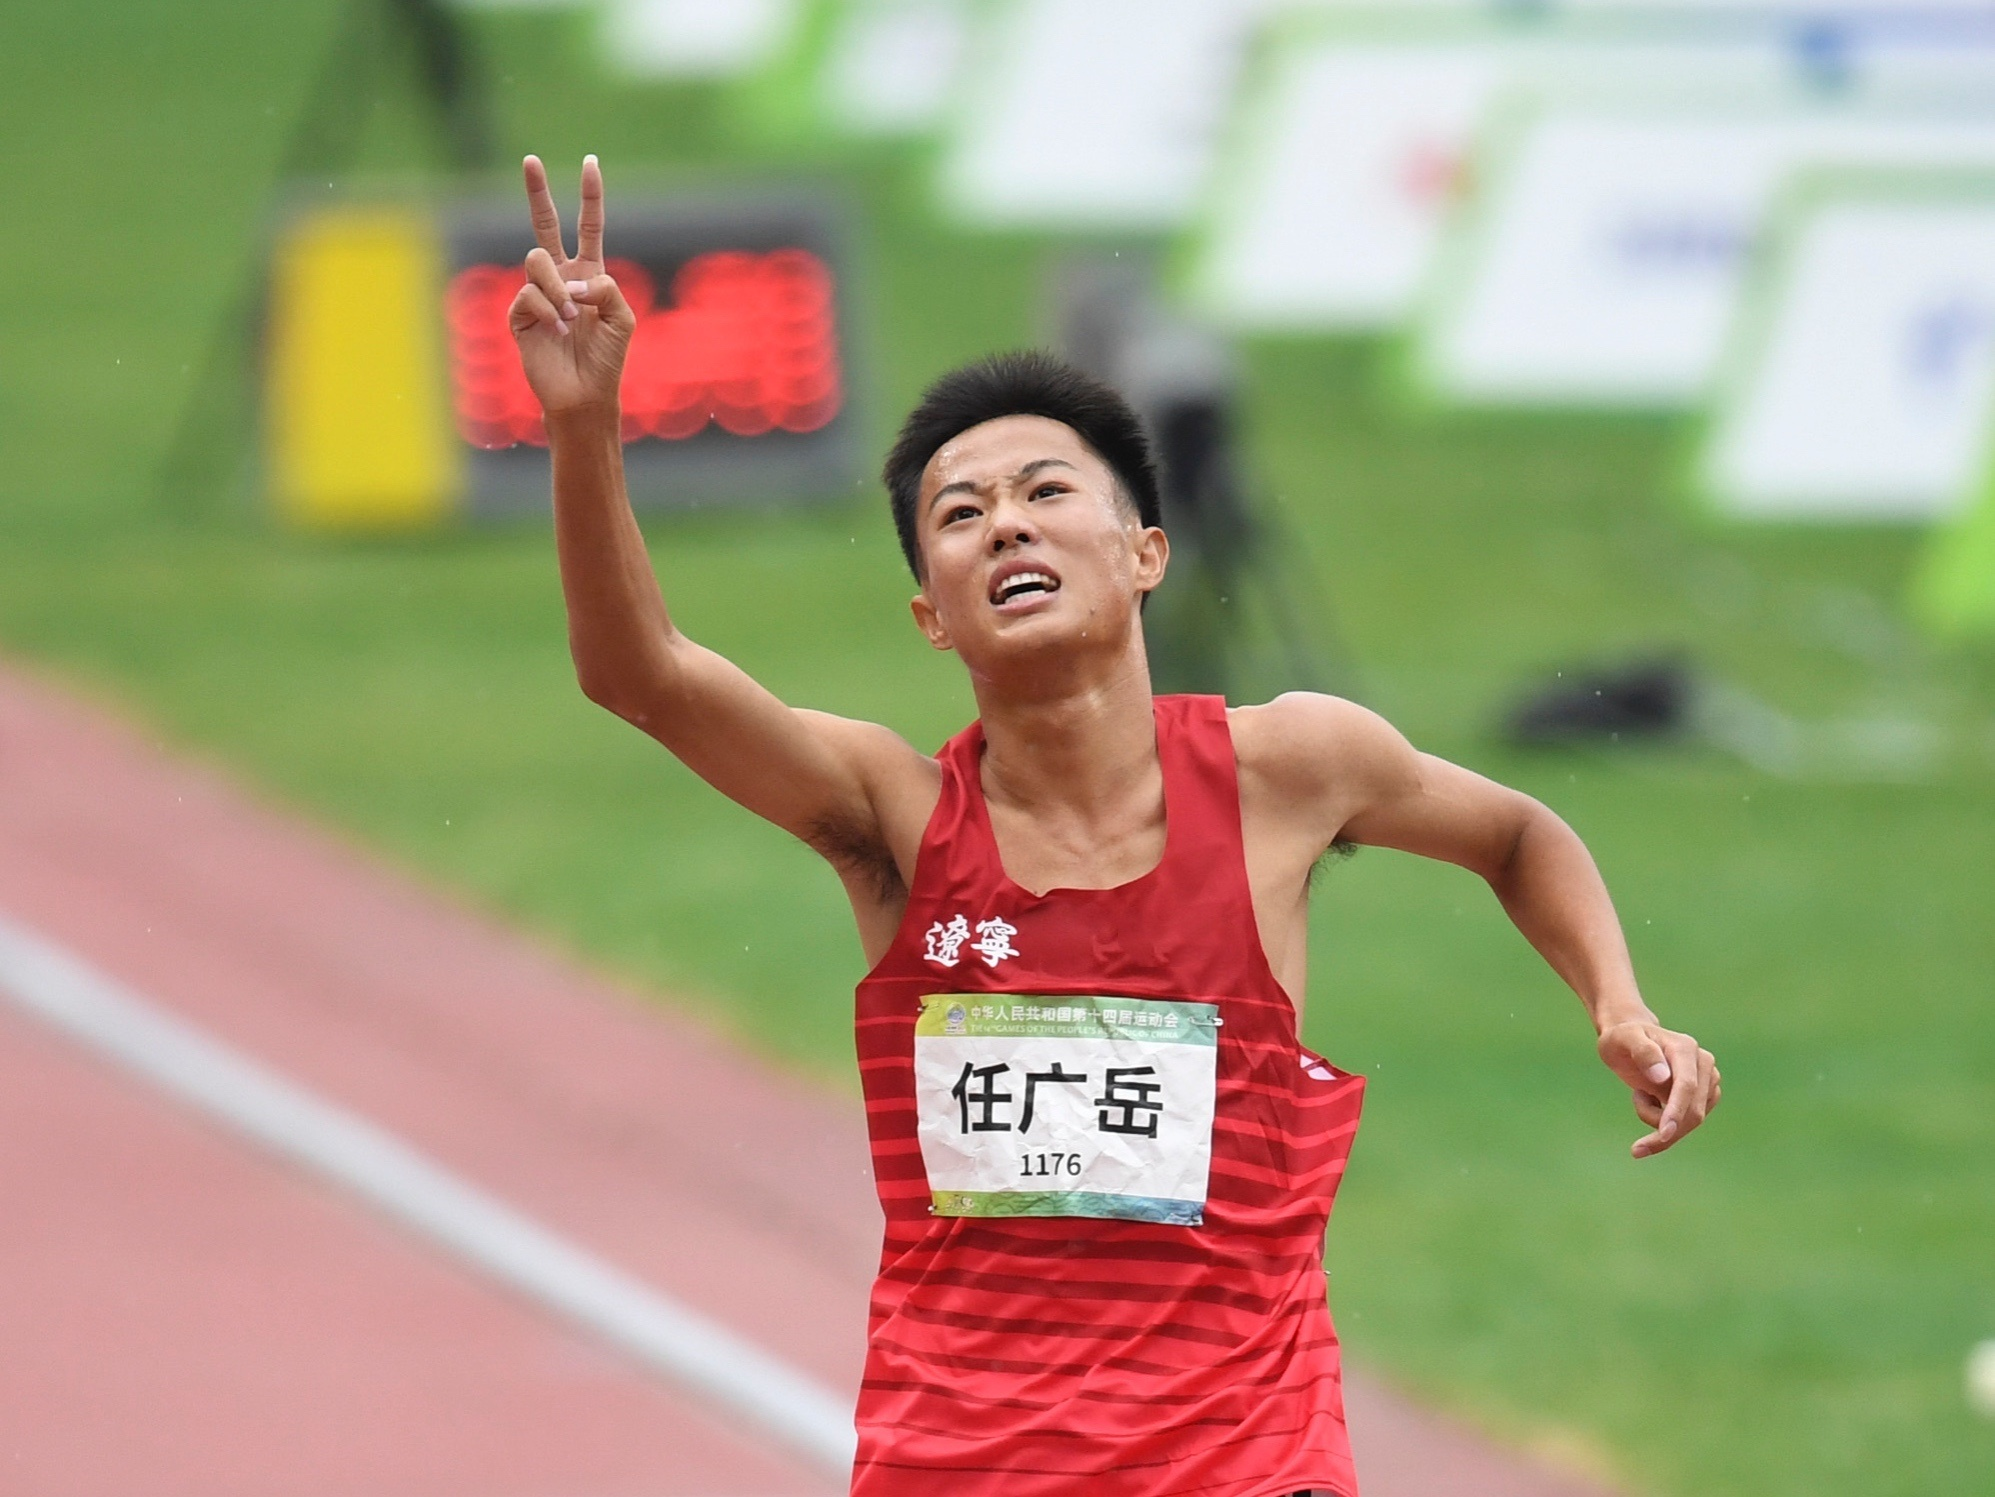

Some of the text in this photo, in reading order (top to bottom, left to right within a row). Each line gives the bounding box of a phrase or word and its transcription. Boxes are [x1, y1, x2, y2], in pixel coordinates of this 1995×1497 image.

[971, 1005, 1178, 1027] 中华人民共和国第十四届运动会
[1151, 1029, 1179, 1039] CHINA
[951, 1062, 1164, 1139] 任广岳
[1020, 1153, 1082, 1176] 1176
